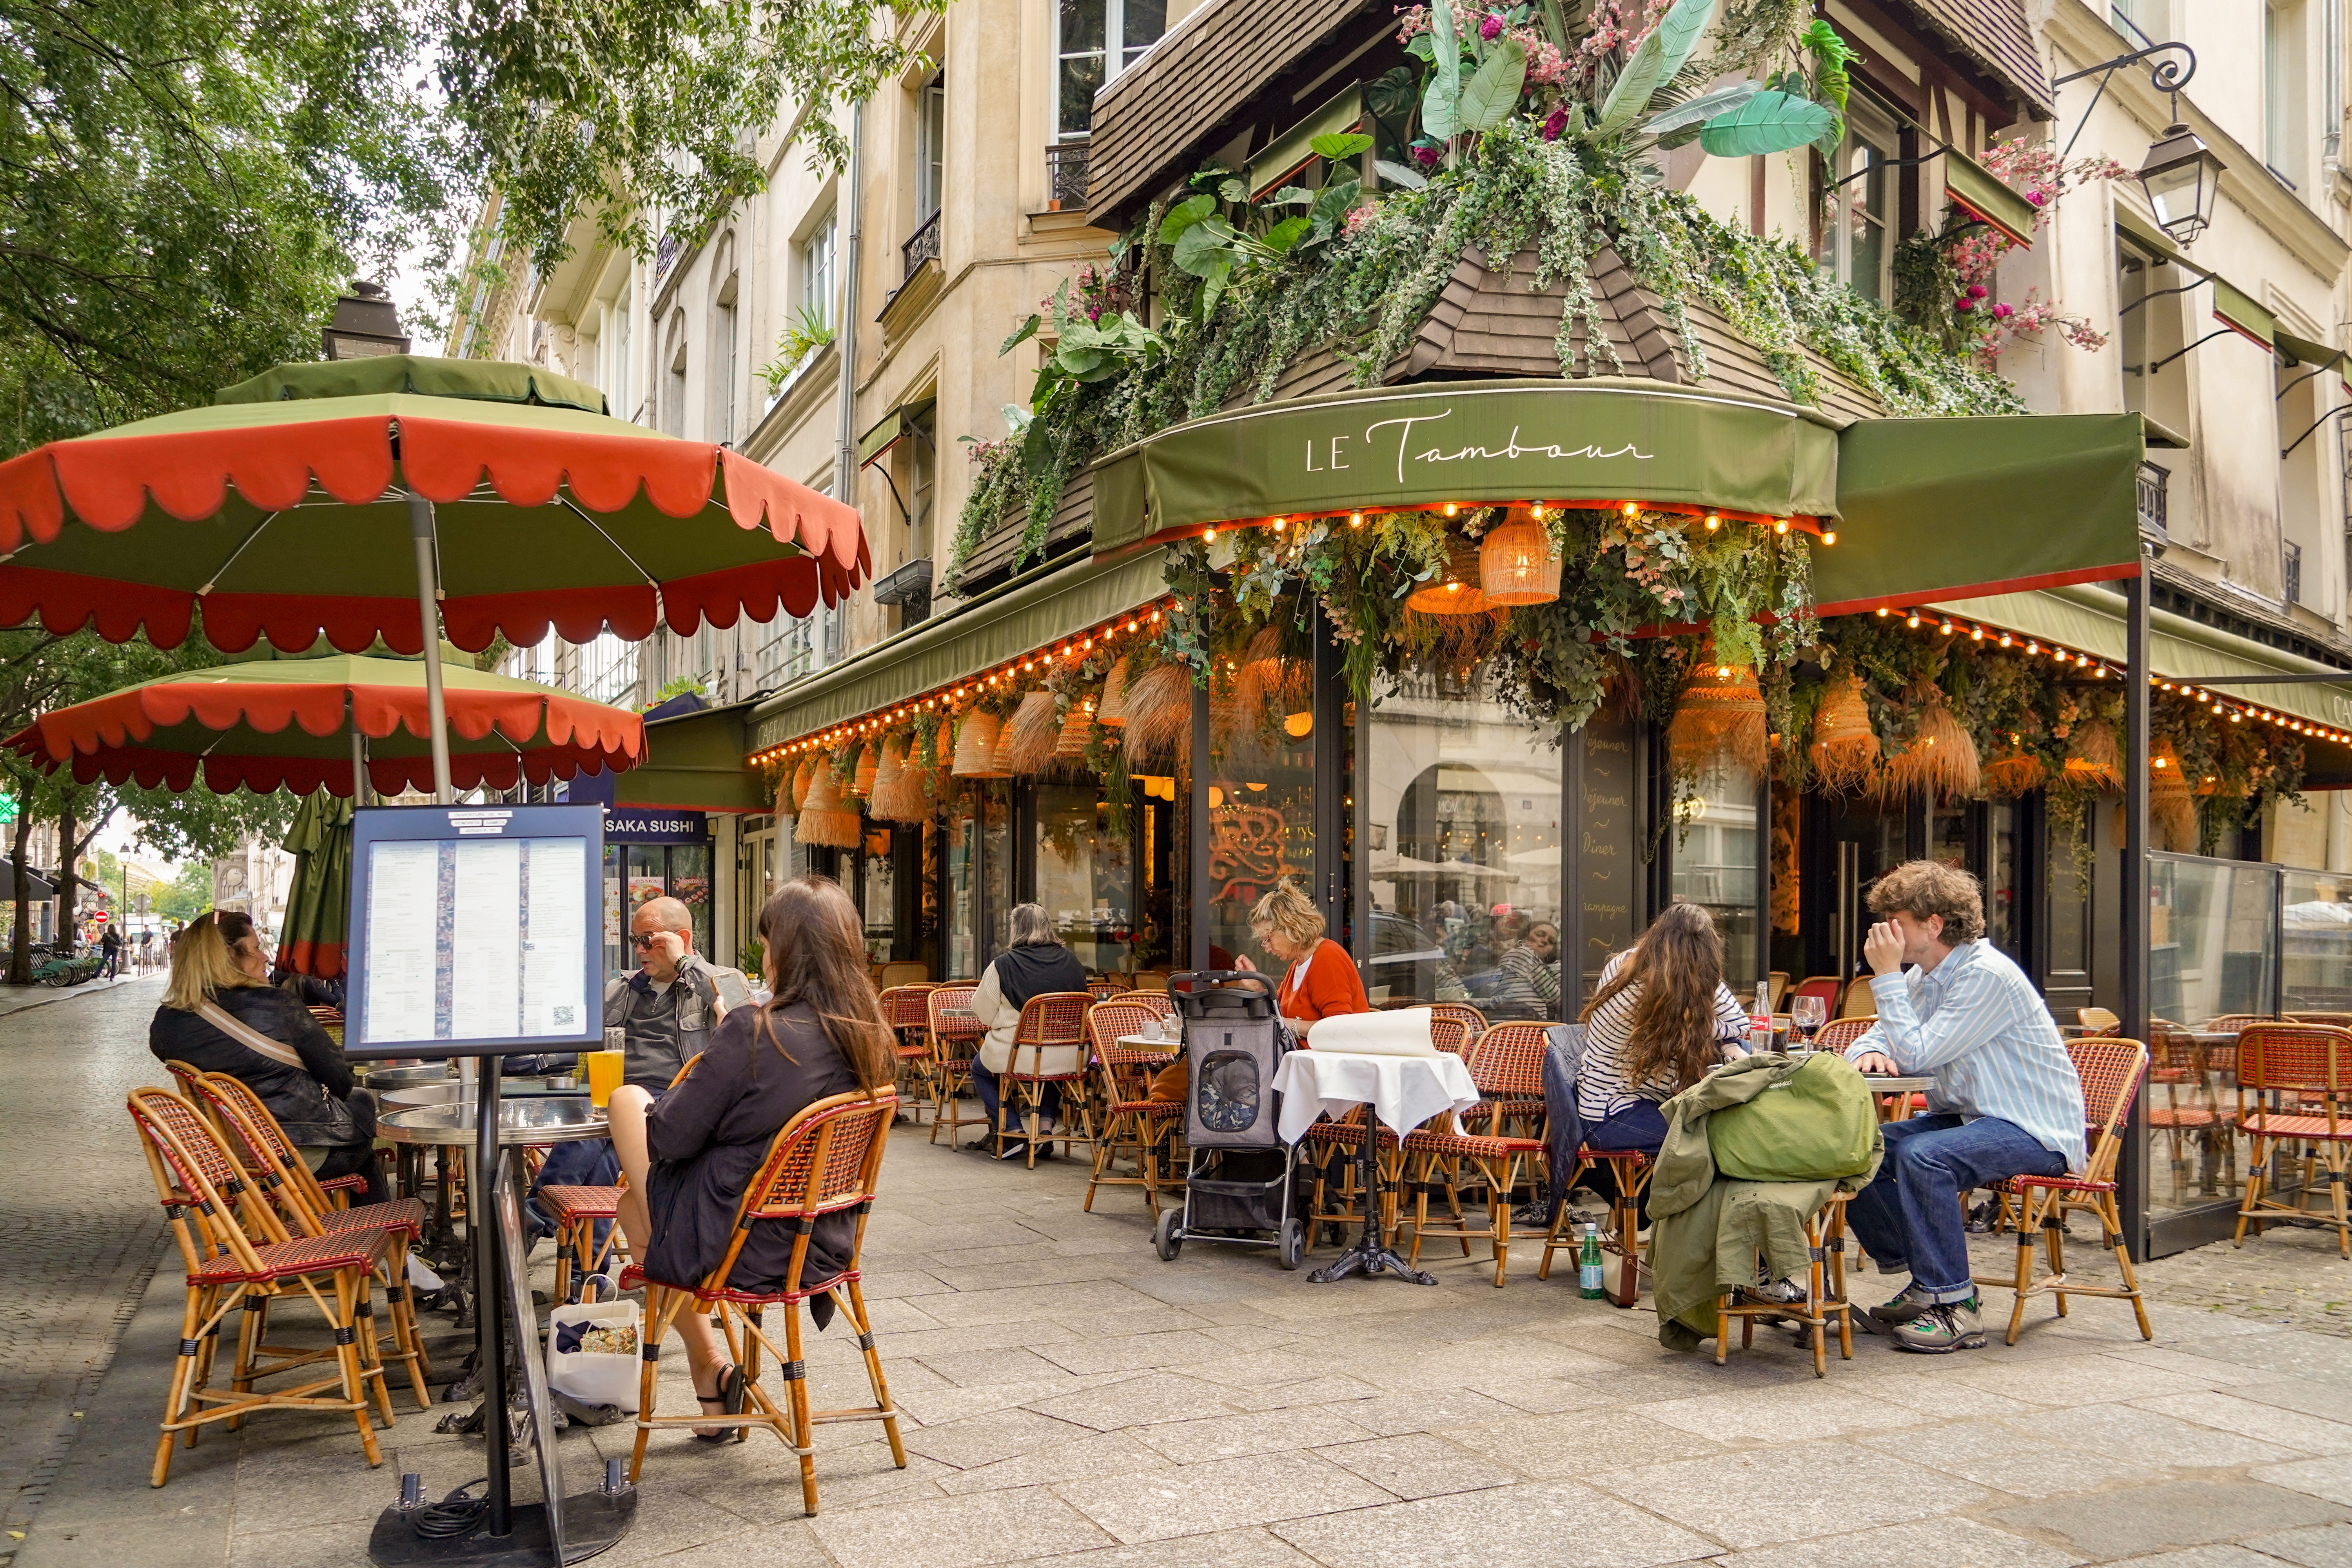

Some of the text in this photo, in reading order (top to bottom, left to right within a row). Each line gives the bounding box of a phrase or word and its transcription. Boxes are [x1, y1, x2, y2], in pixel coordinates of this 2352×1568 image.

[1307, 408, 1654, 483] LE Tambour
[604, 820, 693, 833] SAKA SUSHI
